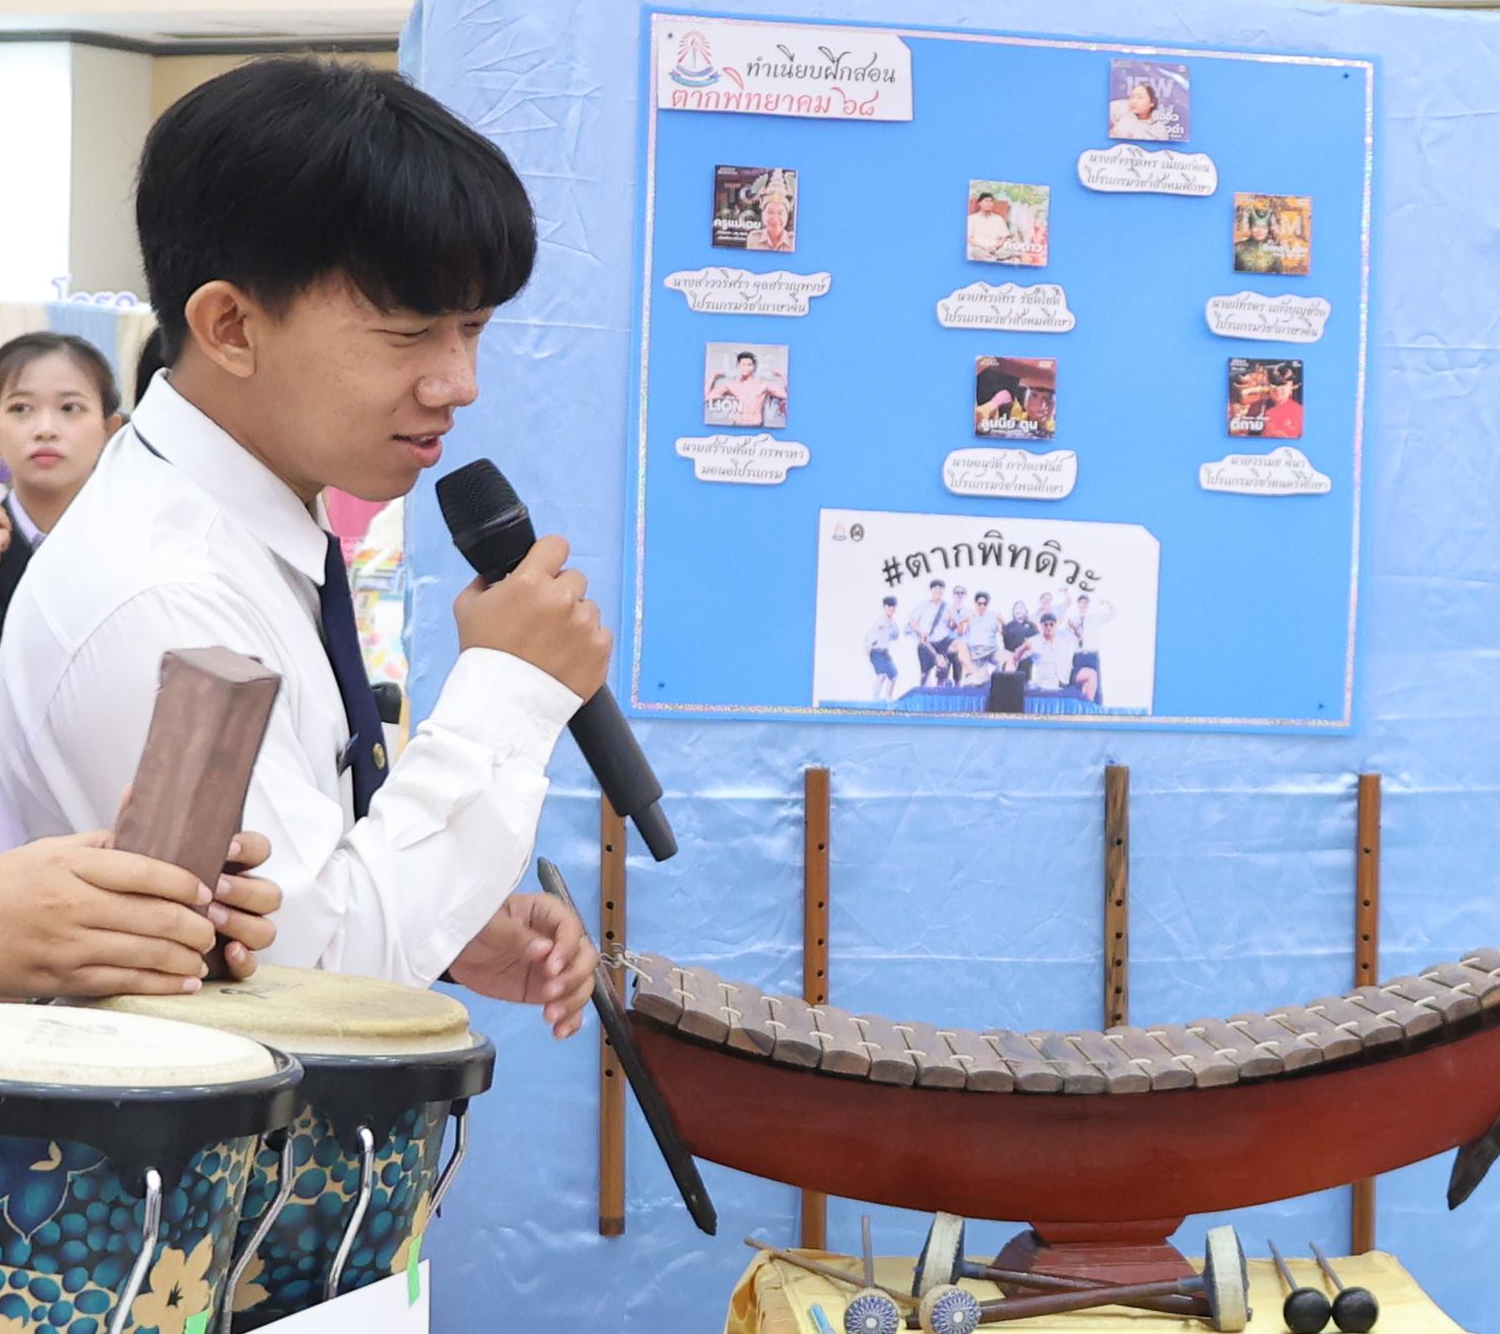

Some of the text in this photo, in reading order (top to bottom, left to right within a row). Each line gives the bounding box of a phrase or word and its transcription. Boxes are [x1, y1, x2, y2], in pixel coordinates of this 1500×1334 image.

[746, 43, 896, 85] ทำเนียบฝึกสอน
[671, 67, 880, 117] ตากพิทยาคม ๖๘
[881, 528, 1103, 593] #ตากพิทดิวะ
